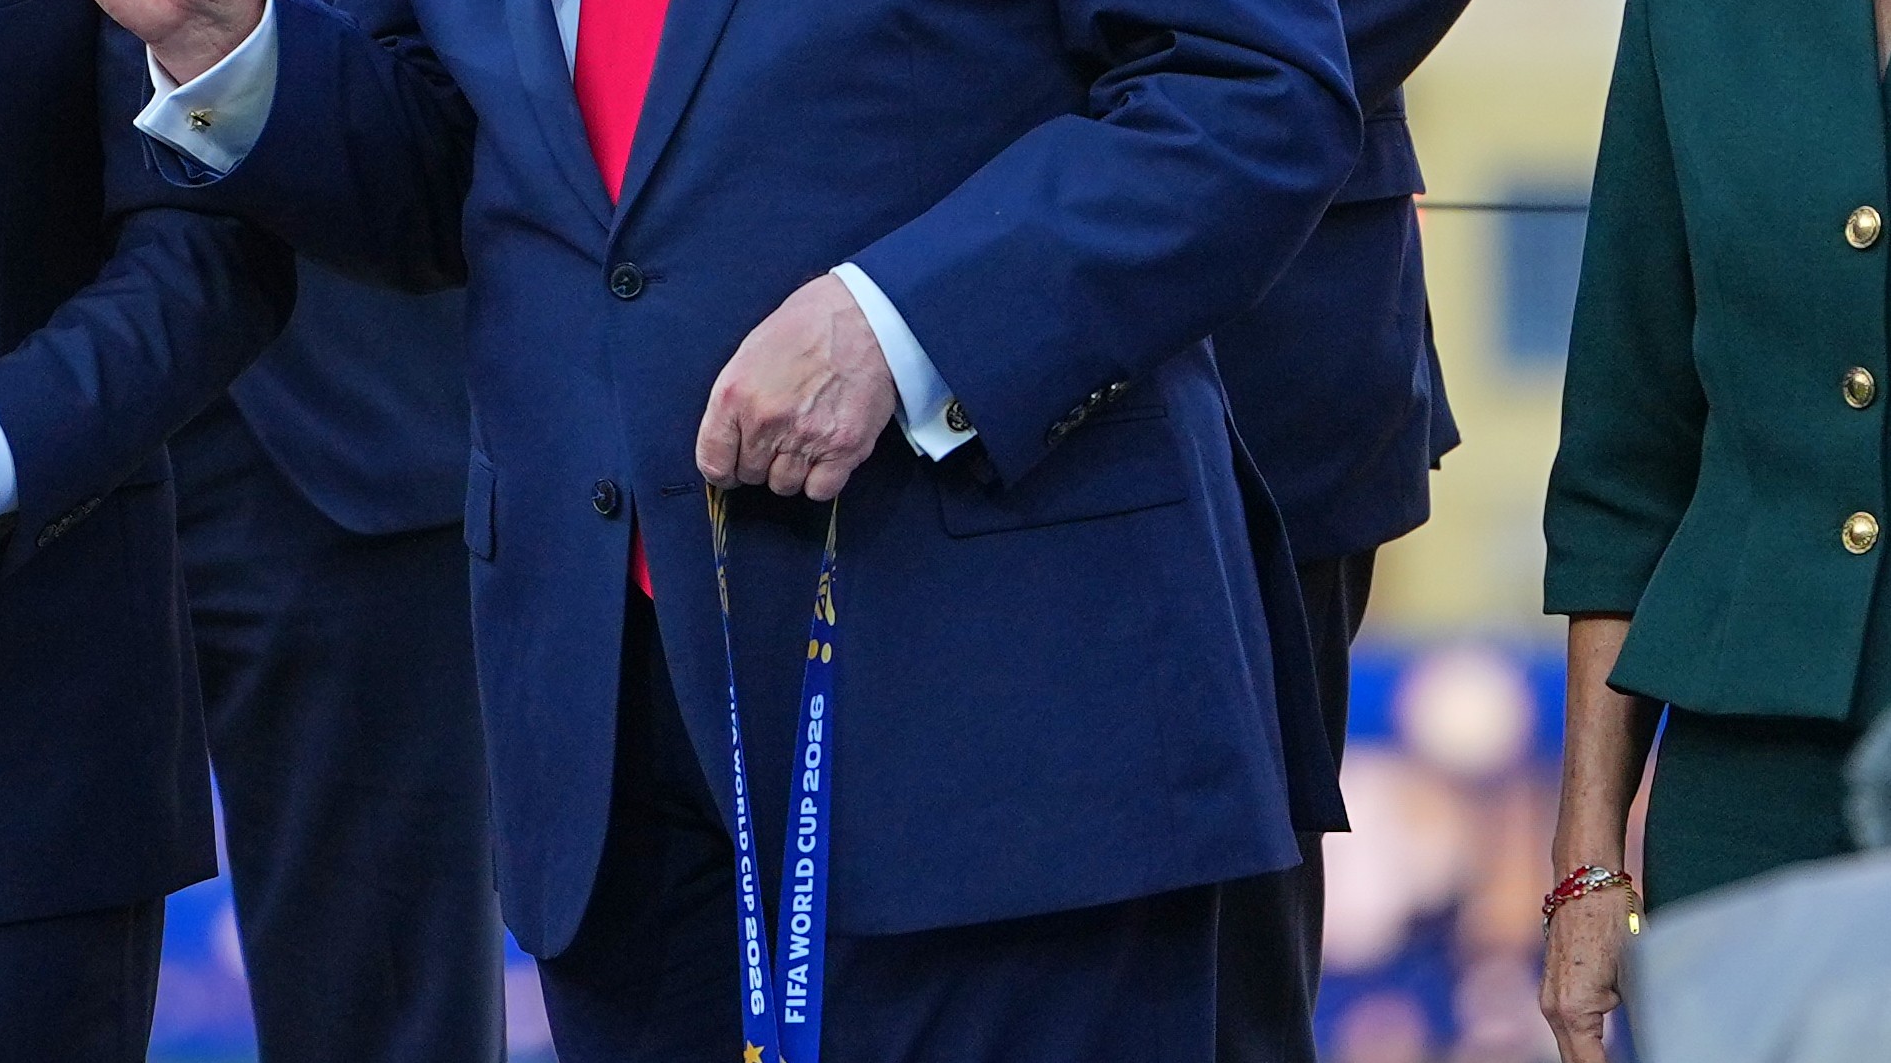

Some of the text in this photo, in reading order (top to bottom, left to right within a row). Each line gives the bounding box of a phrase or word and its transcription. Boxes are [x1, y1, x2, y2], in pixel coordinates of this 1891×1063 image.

[733, 748, 750, 852] WORLD
[741, 854, 756, 913] CUP
[783, 693, 825, 1024] FIFA WORLD CUP 2026
[745, 916, 766, 1017] 2026
